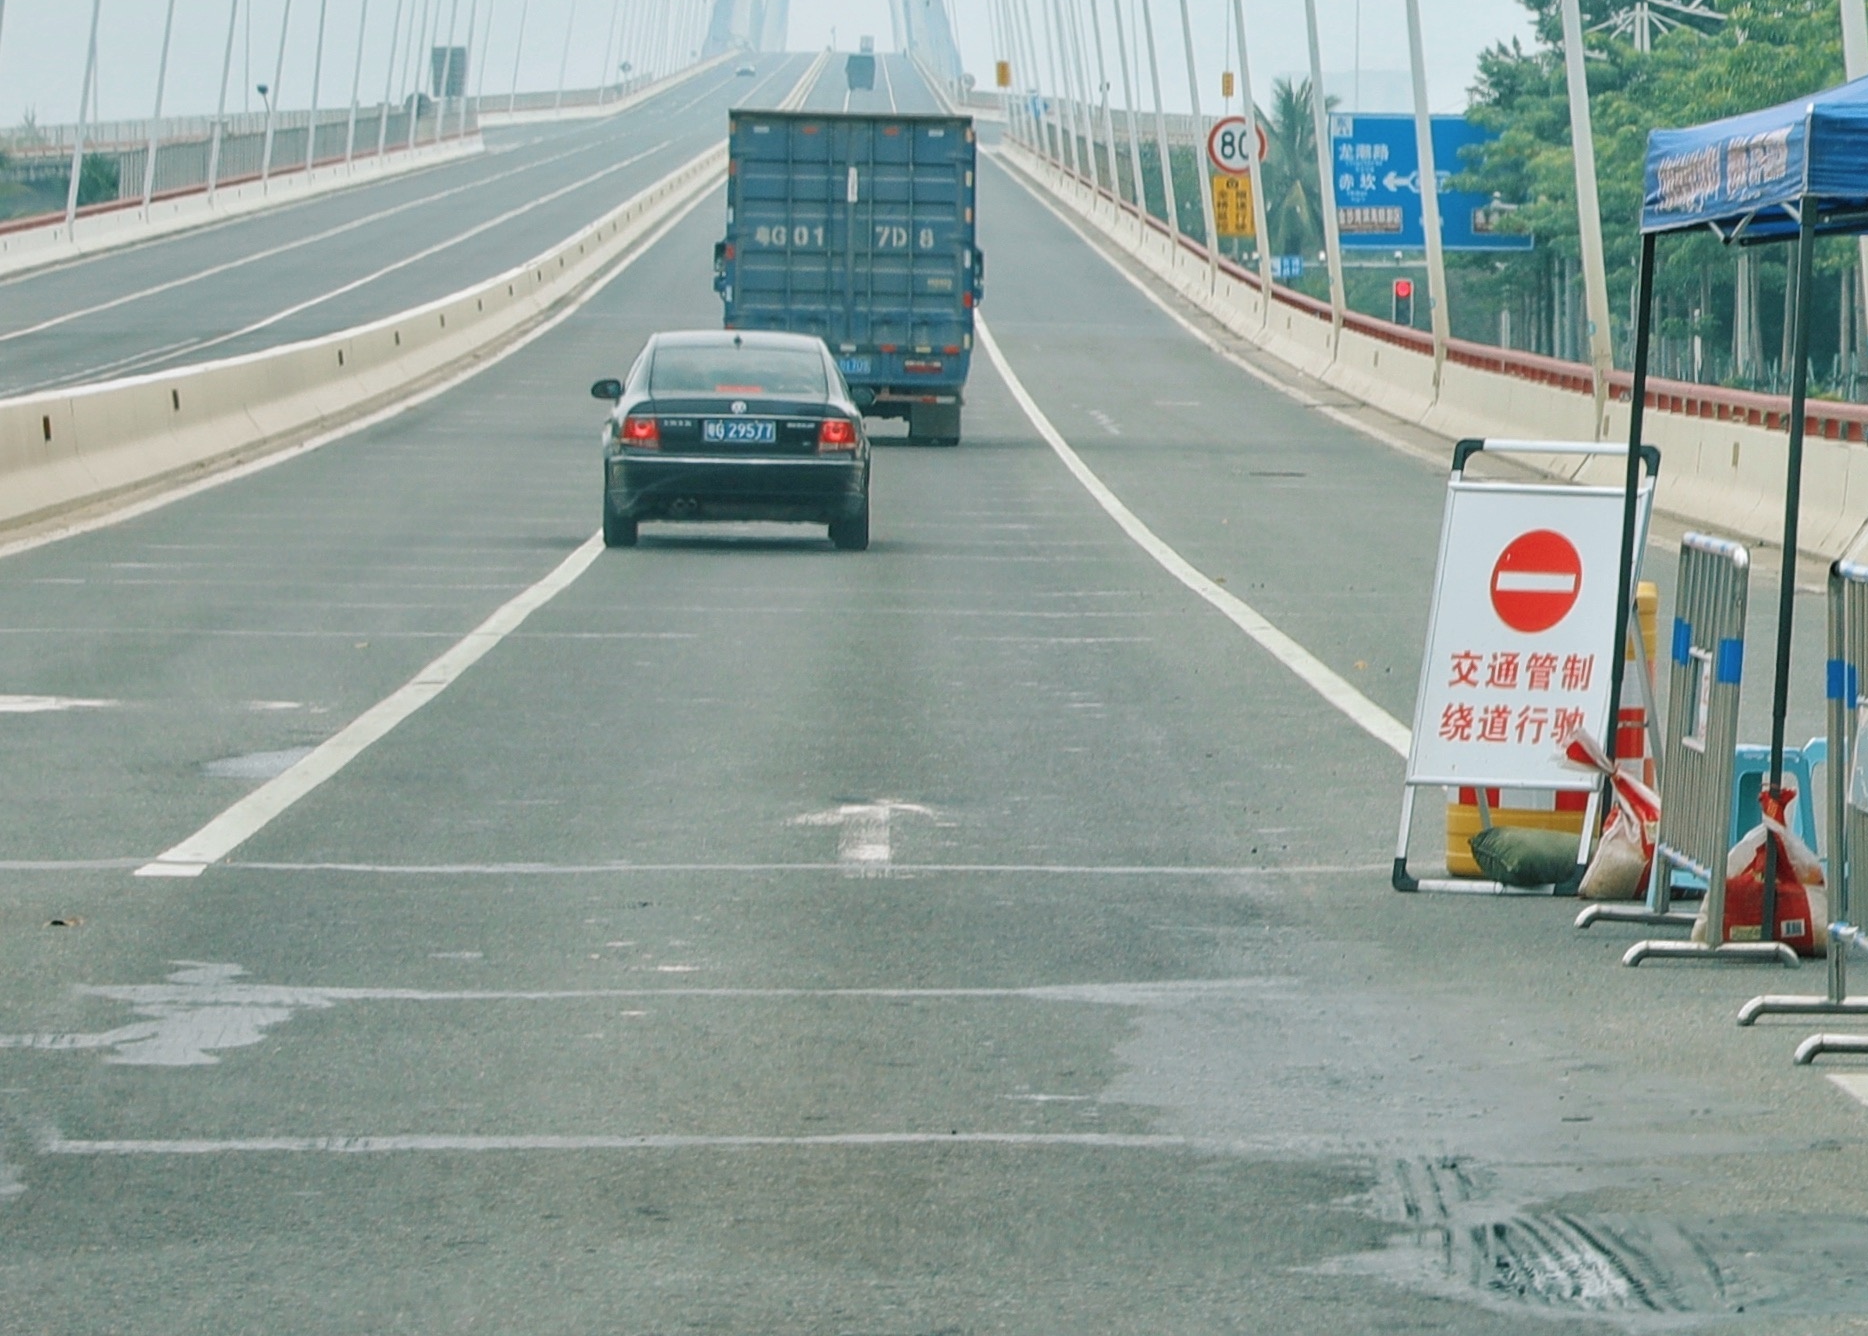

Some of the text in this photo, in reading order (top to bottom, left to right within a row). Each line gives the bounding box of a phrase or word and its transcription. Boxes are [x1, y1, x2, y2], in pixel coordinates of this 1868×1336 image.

[1449, 649, 1595, 692] 交通管制
[1438, 702, 1586, 746] 绕道行驶
